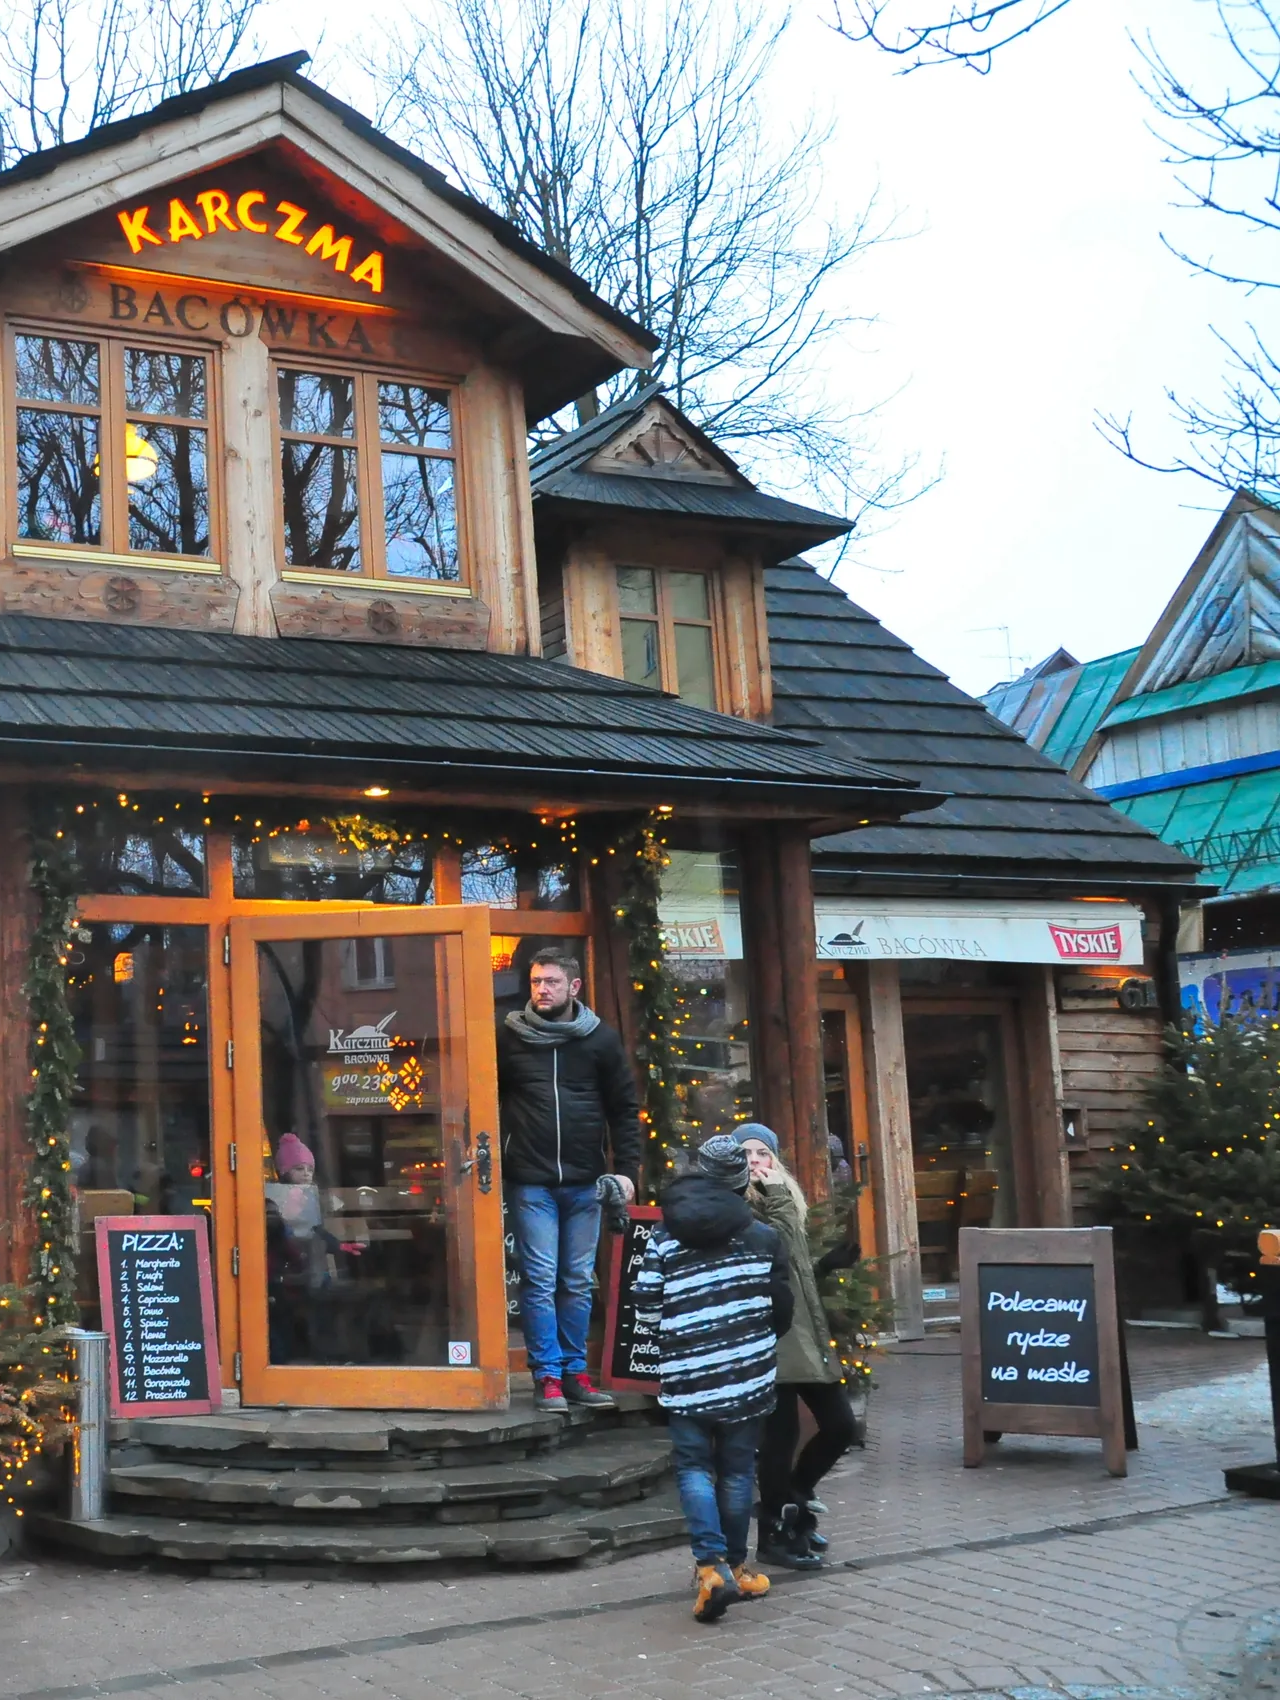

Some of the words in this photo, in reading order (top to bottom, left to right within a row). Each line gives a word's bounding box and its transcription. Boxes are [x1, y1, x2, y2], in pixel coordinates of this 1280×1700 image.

[117, 189, 385, 294] KARCZMA
[108, 283, 376, 354] BACÓWKA
[663, 925, 718, 949] SKIE
[1053, 930, 1119, 955] TYSKIE
[876, 935, 989, 958] BACÓWKA
[328, 1028, 391, 1050] Karczma
[346, 1095, 398, 1106] zapraszam
[121, 1232, 184, 1252] PIZZA:
[135, 1258, 181, 1271] Margherita
[135, 1270, 164, 1283] Funghi
[136, 1282, 165, 1292] Salami
[137, 1293, 180, 1308] Capriciosa
[987, 1290, 1088, 1322] Polecamy
[139, 1317, 170, 1331] Spinaci
[1006, 1328, 1071, 1356] rydze
[142, 1353, 189, 1364] Mozzarella
[143, 1365, 181, 1376] Bacówka
[991, 1366, 1019, 1381] na
[1027, 1361, 1091, 1383] maśle
[144, 1377, 191, 1391] Gorgonzola
[145, 1389, 188, 1400] Prosciutto
